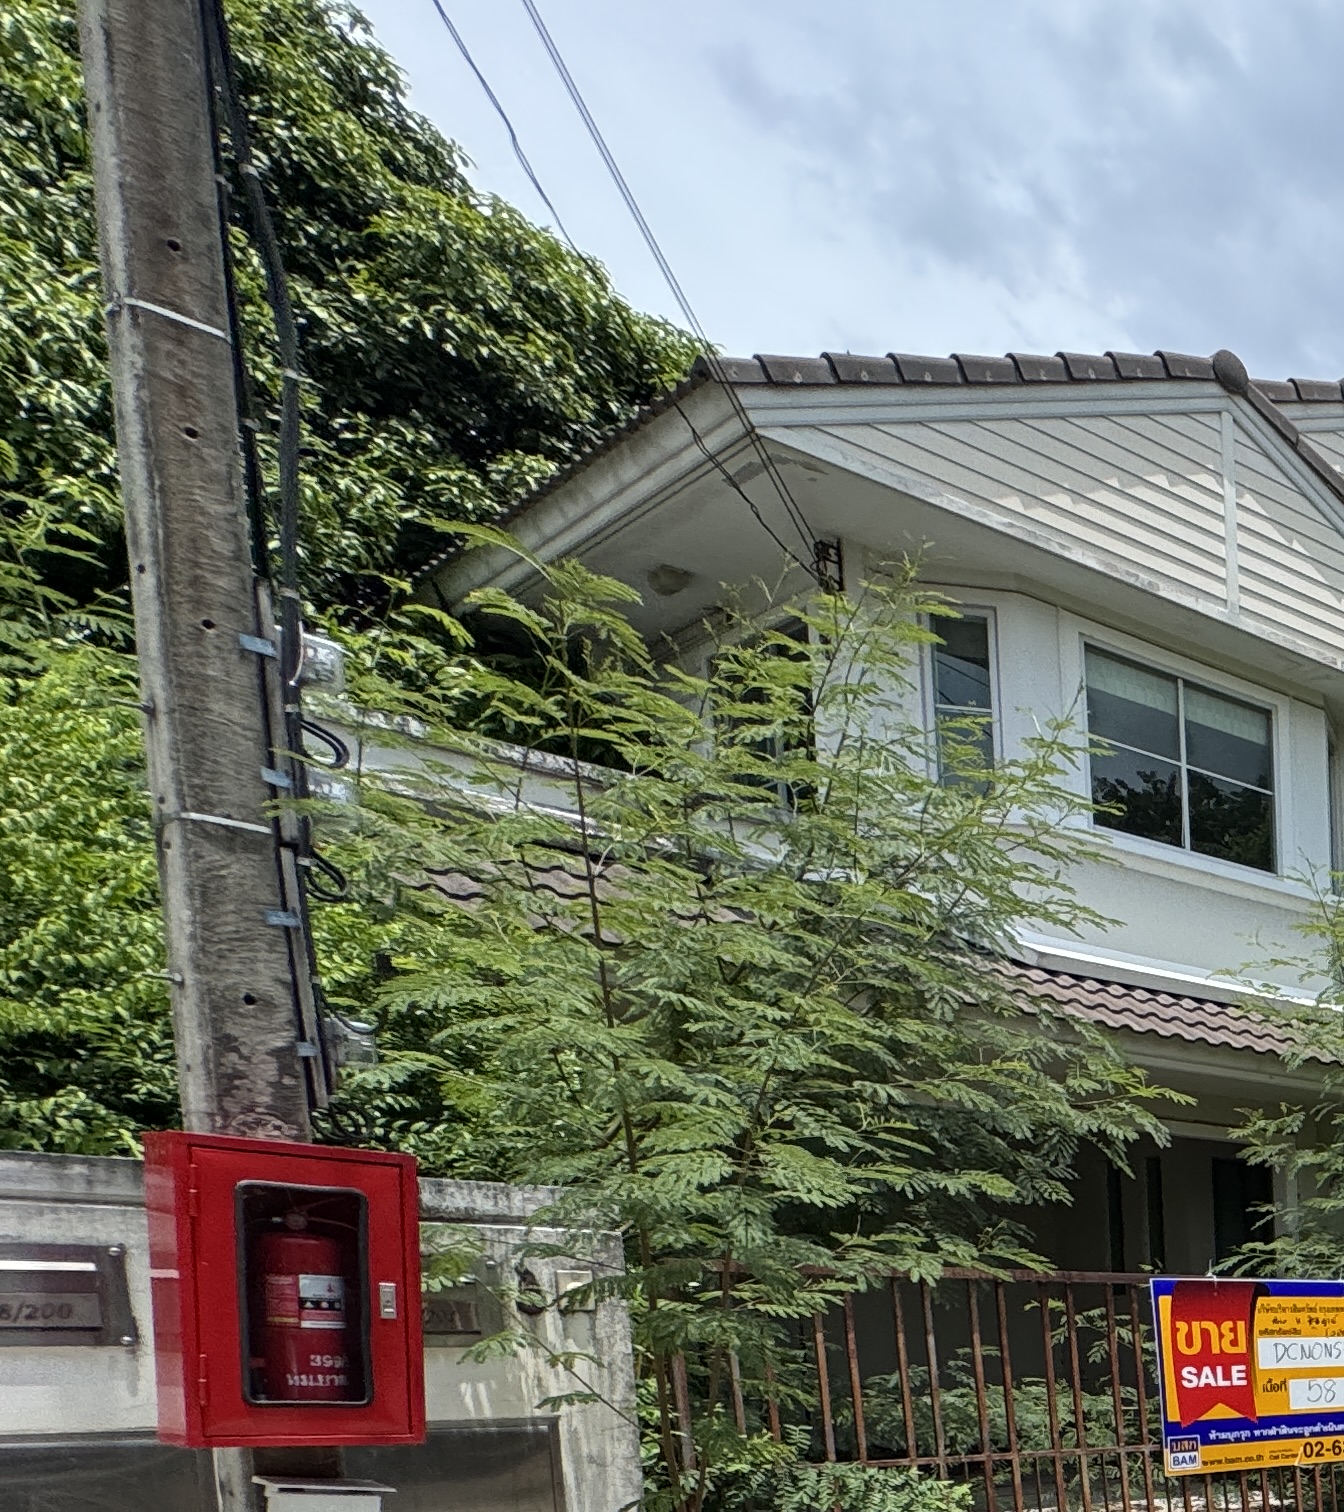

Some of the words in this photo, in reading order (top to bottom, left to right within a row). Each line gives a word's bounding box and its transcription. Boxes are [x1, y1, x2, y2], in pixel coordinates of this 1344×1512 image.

[1175, 1321, 1247, 1355] ขาย
[1181, 1365, 1247, 1388] SALE
[1262, 1378, 1287, 1393] เนื้อที่
[1307, 1379, 1337, 1403] 58
[1172, 1440, 1197, 1452] บสก
[1172, 1454, 1197, 1467] BAM
